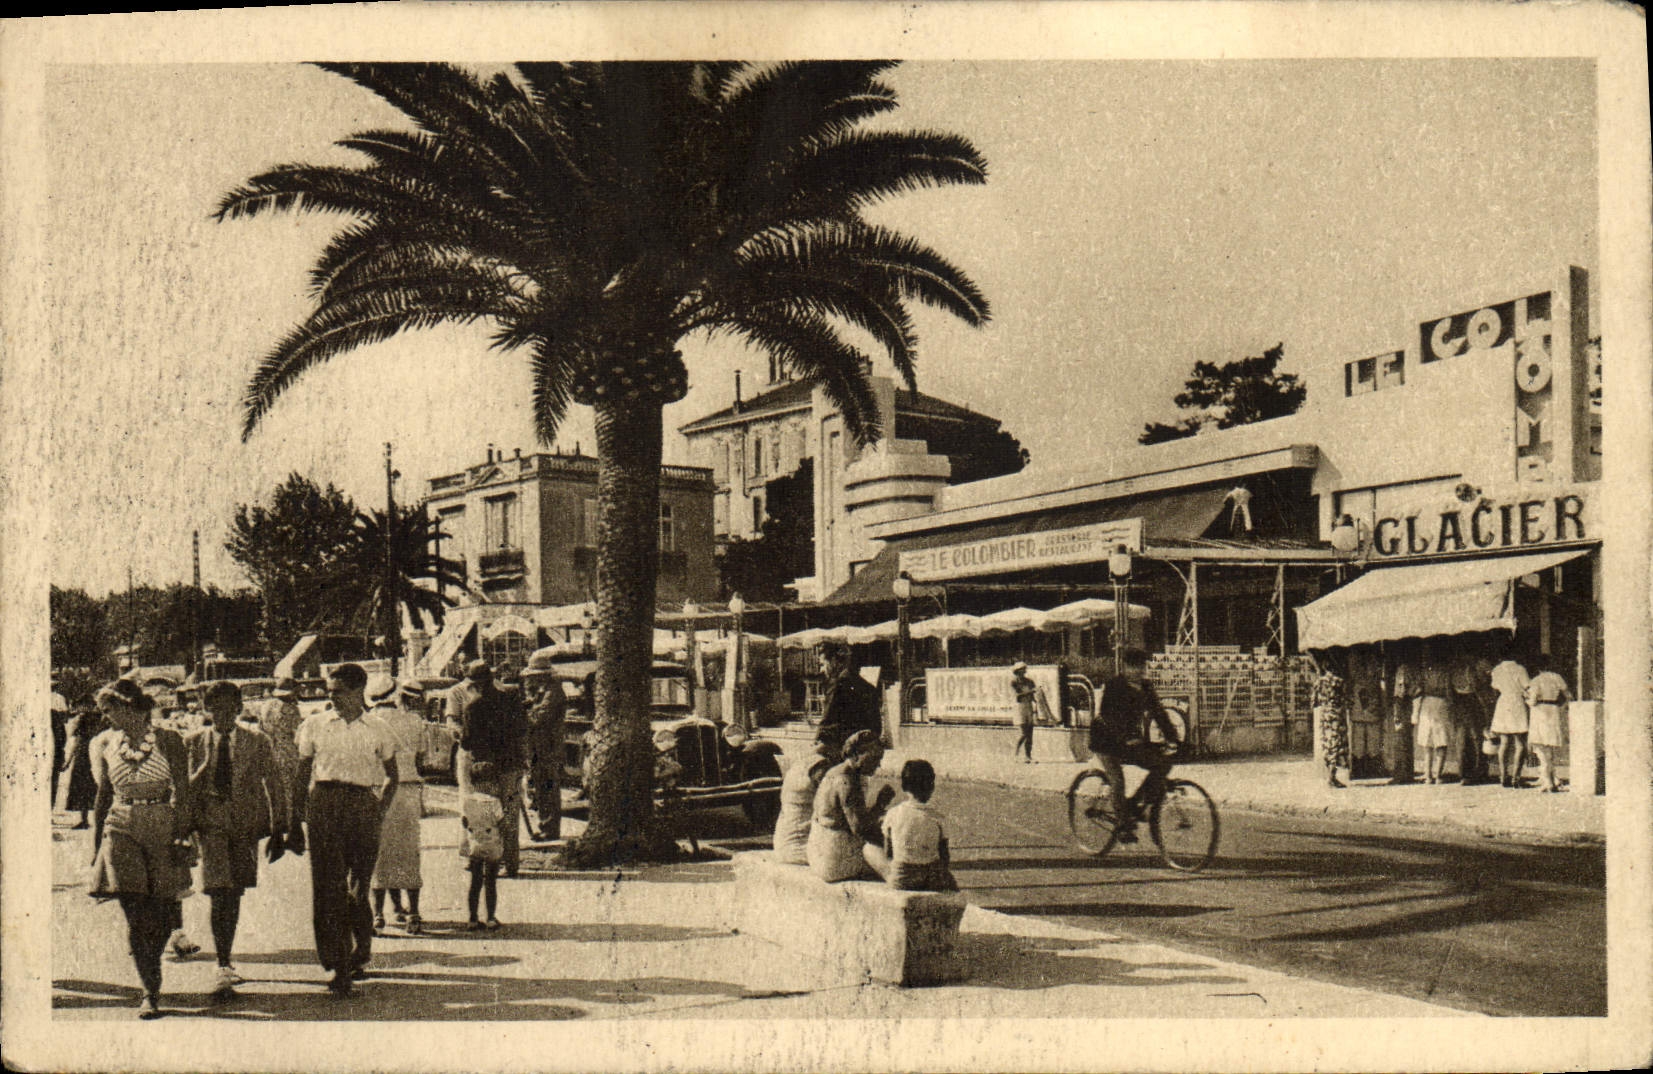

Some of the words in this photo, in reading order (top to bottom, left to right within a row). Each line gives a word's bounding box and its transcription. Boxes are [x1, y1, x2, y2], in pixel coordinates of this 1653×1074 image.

[1349, 352, 1404, 394] LE
[1373, 494, 1586, 556] GLACIER
[931, 551, 947, 571] LE
[953, 538, 1036, 567] COLOMBIER
